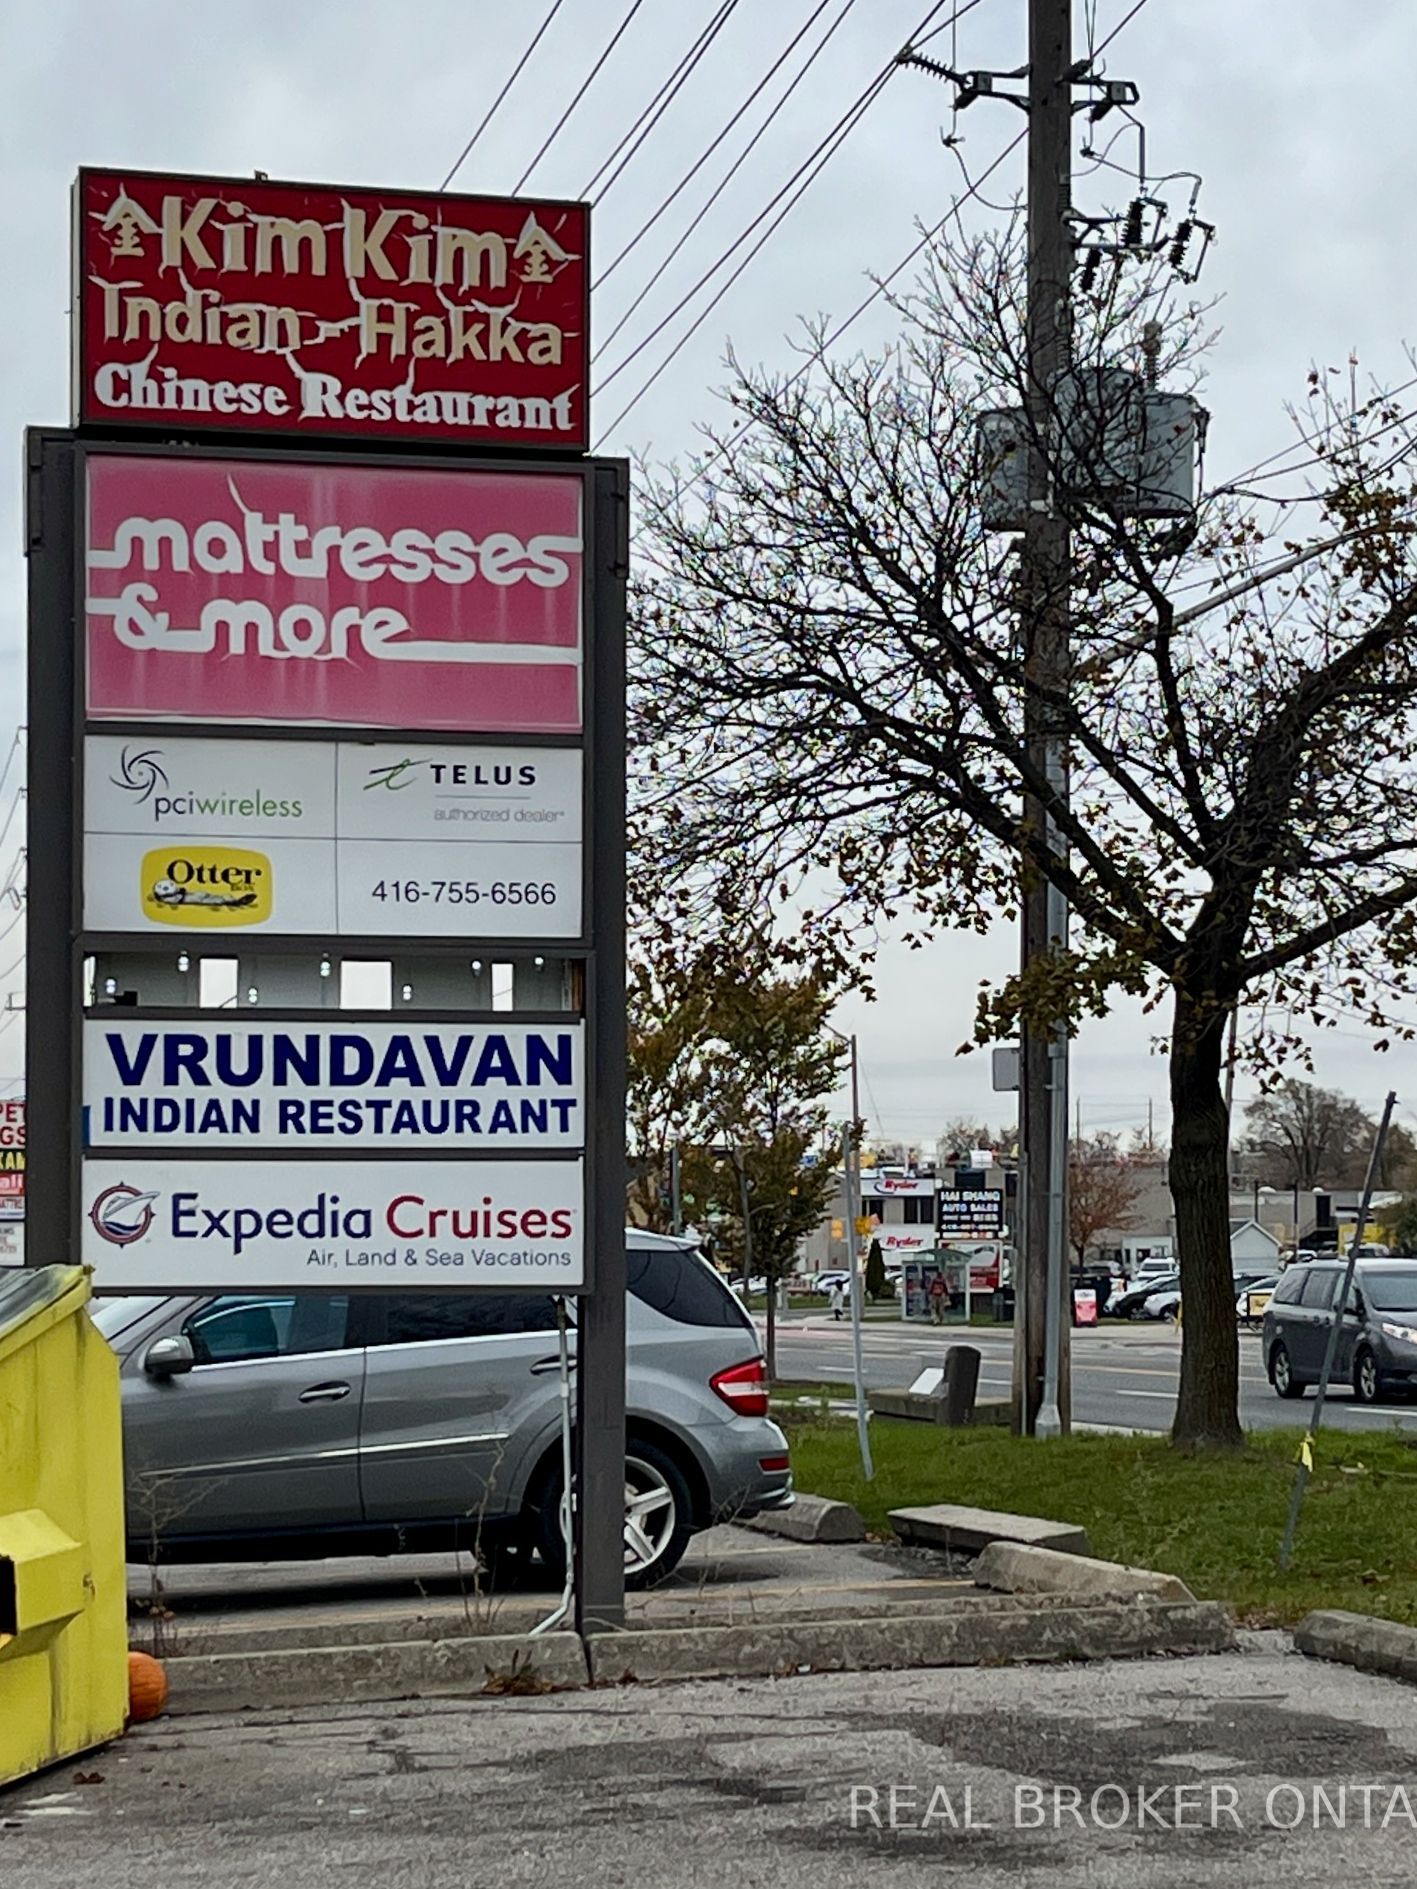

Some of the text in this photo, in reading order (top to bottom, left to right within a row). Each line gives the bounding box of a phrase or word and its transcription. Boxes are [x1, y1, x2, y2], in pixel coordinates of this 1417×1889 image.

[160, 195, 508, 292] Kim Kim
[94, 358, 578, 431] Chinese Restaurant
[92, 511, 580, 588] mattresses
[113, 581, 411, 661] & more
[430, 763, 537, 786] TELUS
[154, 789, 303, 822] pciwireless
[166, 859, 263, 886] Otter
[372, 880, 557, 906] 416-755-6566
[106, 1032, 574, 1087] VRUNDAVAN
[103, 1096, 577, 1134] INDIAN RESTAURANT
[170, 1191, 574, 1256] Expedia Cruises
[886, 1235, 924, 1248] Ryder
[306, 1247, 572, 1269] Air, Land & Sea Vacations
